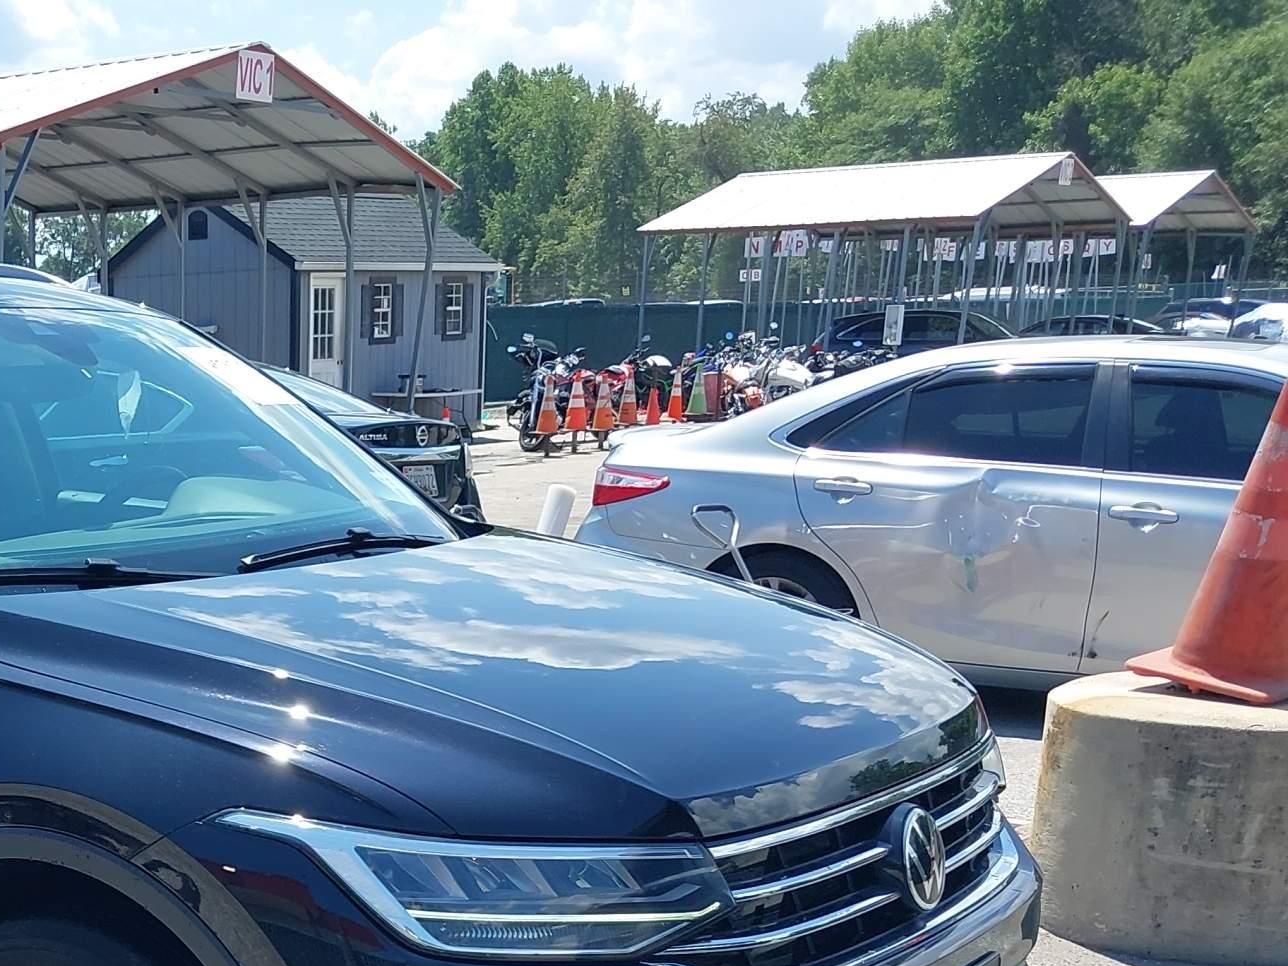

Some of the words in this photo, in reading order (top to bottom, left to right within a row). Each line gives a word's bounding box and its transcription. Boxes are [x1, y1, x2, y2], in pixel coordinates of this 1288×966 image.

[240, 56, 263, 94] VIC
[266, 61, 273, 96] 1
[795, 240, 804, 252] P
[1103, 241, 1112, 252] Y
